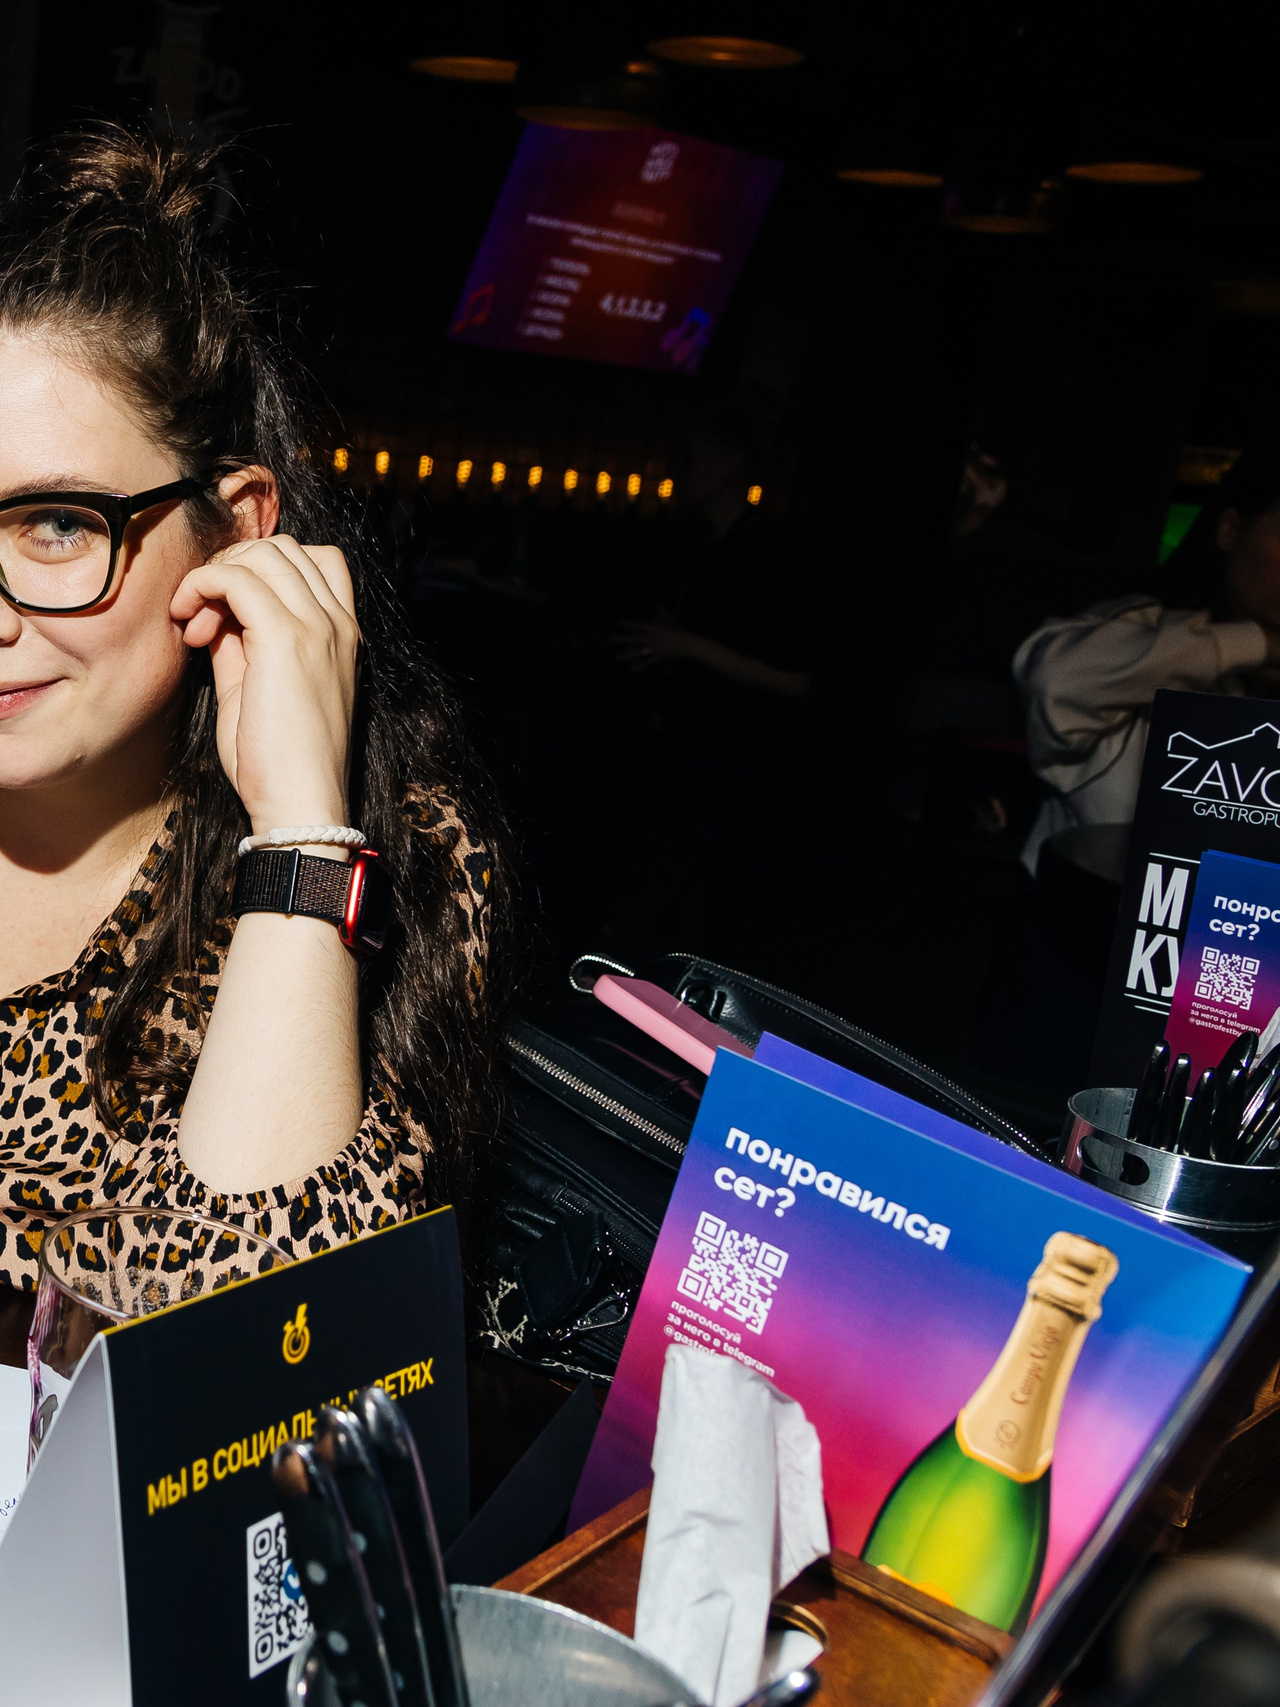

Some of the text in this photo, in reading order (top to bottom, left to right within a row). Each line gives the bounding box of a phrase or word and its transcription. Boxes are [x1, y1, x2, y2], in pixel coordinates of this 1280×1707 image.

[1209, 918, 1260, 941] сет?
[1191, 1001, 1238, 1019] проголосуй
[1200, 1012, 1219, 1022] него
[1227, 1019, 1261, 1034] telegram
[714, 1167, 796, 1218] сет?
[725, 1127, 951, 1251] понравился
[663, 1324, 720, 1356] @gastrof
[671, 1300, 741, 1344] проголосуй
[667, 1313, 776, 1378] за него в telegram
[147, 1466, 188, 1517] МЫ
[192, 1457, 210, 1495] В
[213, 1388, 359, 1481] СОЦИАЛЬ
